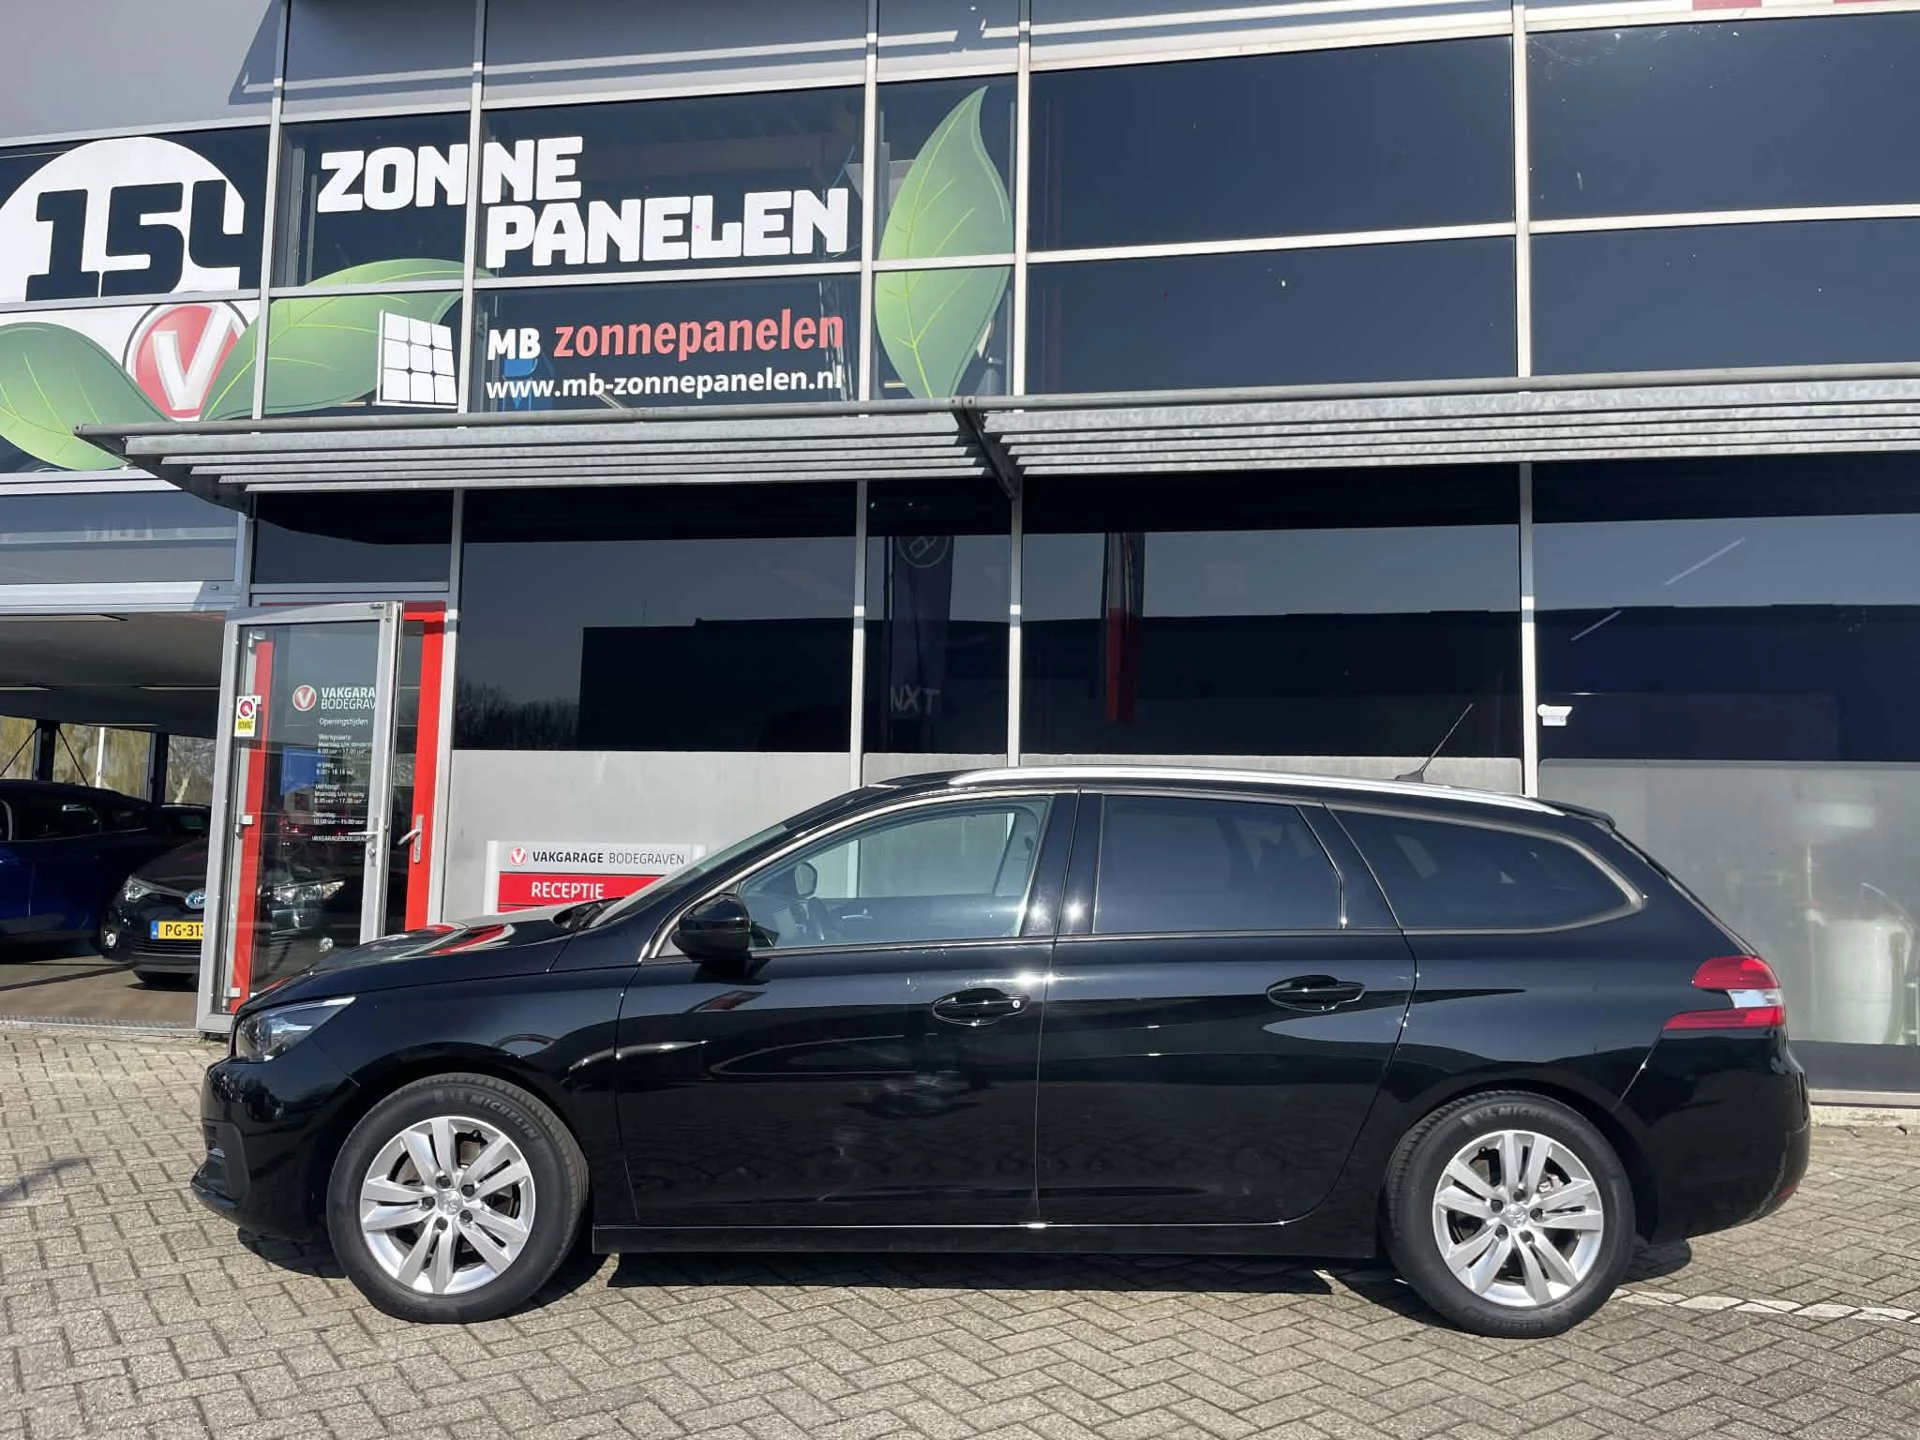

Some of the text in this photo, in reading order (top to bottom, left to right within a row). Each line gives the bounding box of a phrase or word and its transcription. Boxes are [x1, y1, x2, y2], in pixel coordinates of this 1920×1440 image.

[317, 135, 583, 213] ZONNE
[485, 187, 849, 269] PANELEN
[487, 308, 844, 362] MB zonnepanelen
[486, 364, 843, 400] www.mb-zonnepanelen.nl
[532, 851, 604, 863] VAKGARAGE
[608, 852, 685, 865] BODEGRAVEN
[531, 881, 605, 899] RECEPTIE
